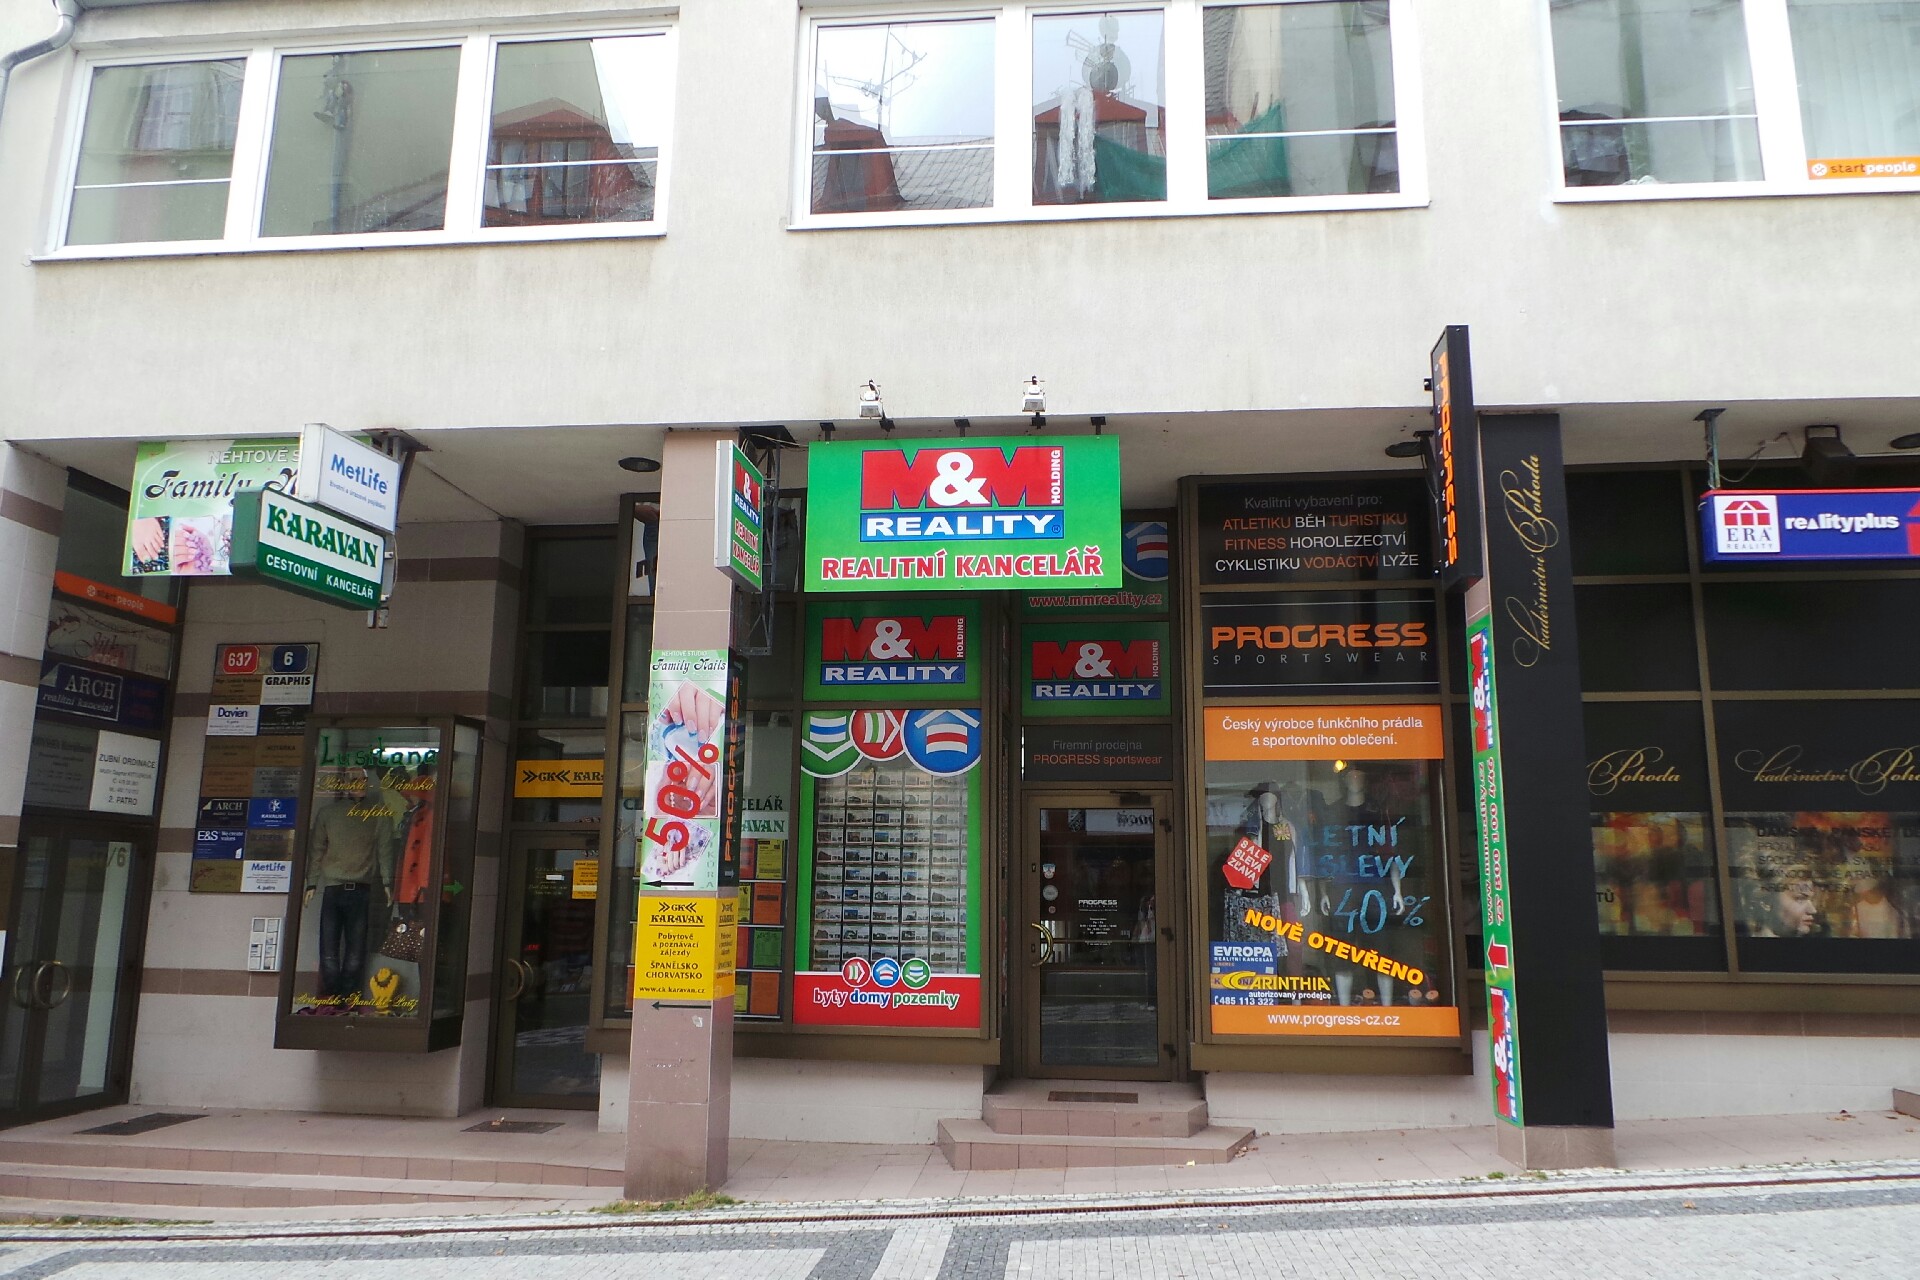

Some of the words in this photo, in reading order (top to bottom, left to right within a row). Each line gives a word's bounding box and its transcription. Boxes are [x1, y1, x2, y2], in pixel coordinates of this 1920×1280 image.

[208, 447, 289, 464] NEHTOVÉ
[331, 454, 387, 494] MetLife
[861, 446, 1063, 509] M&M
[1050, 450, 1062, 504] HOLDING
[735, 493, 759, 525] REALITY
[1244, 497, 1291, 509] Kvalitní
[1294, 495, 1354, 510] vybavení
[1357, 494, 1383, 508] pro:
[1500, 454, 1559, 553] Pohoda
[866, 515, 1056, 537] REALITY
[1223, 517, 1291, 531] ATLETIKU
[1294, 513, 1326, 528] BĚH
[1329, 513, 1407, 527] TURISTIKU
[1785, 513, 1899, 533] realityplus
[266, 503, 379, 568] KARAVAN
[1225, 537, 1287, 550] FITNESS
[1290, 531, 1406, 549] HOROLEZECTVÍ
[1727, 528, 1771, 542] ERA
[821, 548, 947, 580] REALITNÍ
[955, 545, 1104, 577] KANCELÁŘ
[1215, 558, 1300, 572] CYKLISTIKU
[1304, 552, 1379, 569] VODÁCTVÍ
[1382, 552, 1419, 567] LYŽE
[265, 553, 317, 581] CESTOVNÍ
[325, 573, 374, 600] KANCELÁŘ
[1029, 592, 1162, 609] www.mmreality.cz
[821, 616, 966, 661] M&M
[956, 618, 965, 658] HOLDING
[1211, 622, 1428, 650] PROGRESS
[228, 652, 252, 667] 637
[283, 651, 294, 666] 6
[652, 659, 690, 674] Family
[694, 659, 726, 671] Nails
[1031, 640, 1159, 680] M&M
[1212, 652, 1428, 665] SPORTSWEAR
[265, 677, 311, 686] GRAPHIS
[825, 666, 959, 681] REALITY
[65, 675, 117, 700] ARCH
[1035, 684, 1154, 697] REALITY
[217, 707, 248, 718] Davien
[1223, 716, 1261, 732] Český
[1264, 717, 1314, 731] výrobce
[1317, 717, 1379, 729] funkčního
[1382, 717, 1423, 730] prádla
[1053, 740, 1093, 750] Firemní
[1096, 740, 1142, 752] prodejna
[1252, 737, 1260, 746] a
[1263, 733, 1336, 748] sportovního
[1340, 733, 1398, 746] oblečení.
[99, 754, 120, 763] ZUBNÍ
[123, 757, 156, 768] ORDINACE
[724, 676, 739, 862] PROGRESS
[1033, 754, 1100, 765] PROGRESS
[1103, 755, 1162, 767] sportswear
[1585, 746, 1681, 796] Pohoda
[216, 802, 243, 810] ARCH
[645, 743, 719, 852] 50%
[197, 830, 218, 841] E&S
[1240, 840, 1270, 863] SALE
[251, 863, 286, 871] MetLife
[1235, 849, 1262, 872] SLEVA
[1319, 855, 1415, 879] SLEVY
[651, 915, 704, 924] KARAVAN
[658, 932, 693, 941] Pobytové
[659, 941, 699, 950] poznávací
[660, 949, 690, 957] zájezdy
[1213, 946, 1273, 957] EVROPA
[1244, 909, 1304, 943] NOVĚ
[1308, 932, 1425, 986] OTEVŘENO
[650, 960, 698, 969] ŠPANĚLSKO
[645, 971, 703, 980] CHORVATSKO
[813, 987, 848, 1008] byty
[849, 988, 891, 1007] domy
[892, 989, 960, 1010] pozemky
[1219, 997, 1236, 1006] 485
[1239, 997, 1255, 1006] 113
[1257, 998, 1274, 1006] 322
[1248, 991, 1296, 1000] autorizovaný
[1298, 991, 1332, 1000] prodejce
[1268, 1012, 1400, 1028] www.progress-cz.cz
